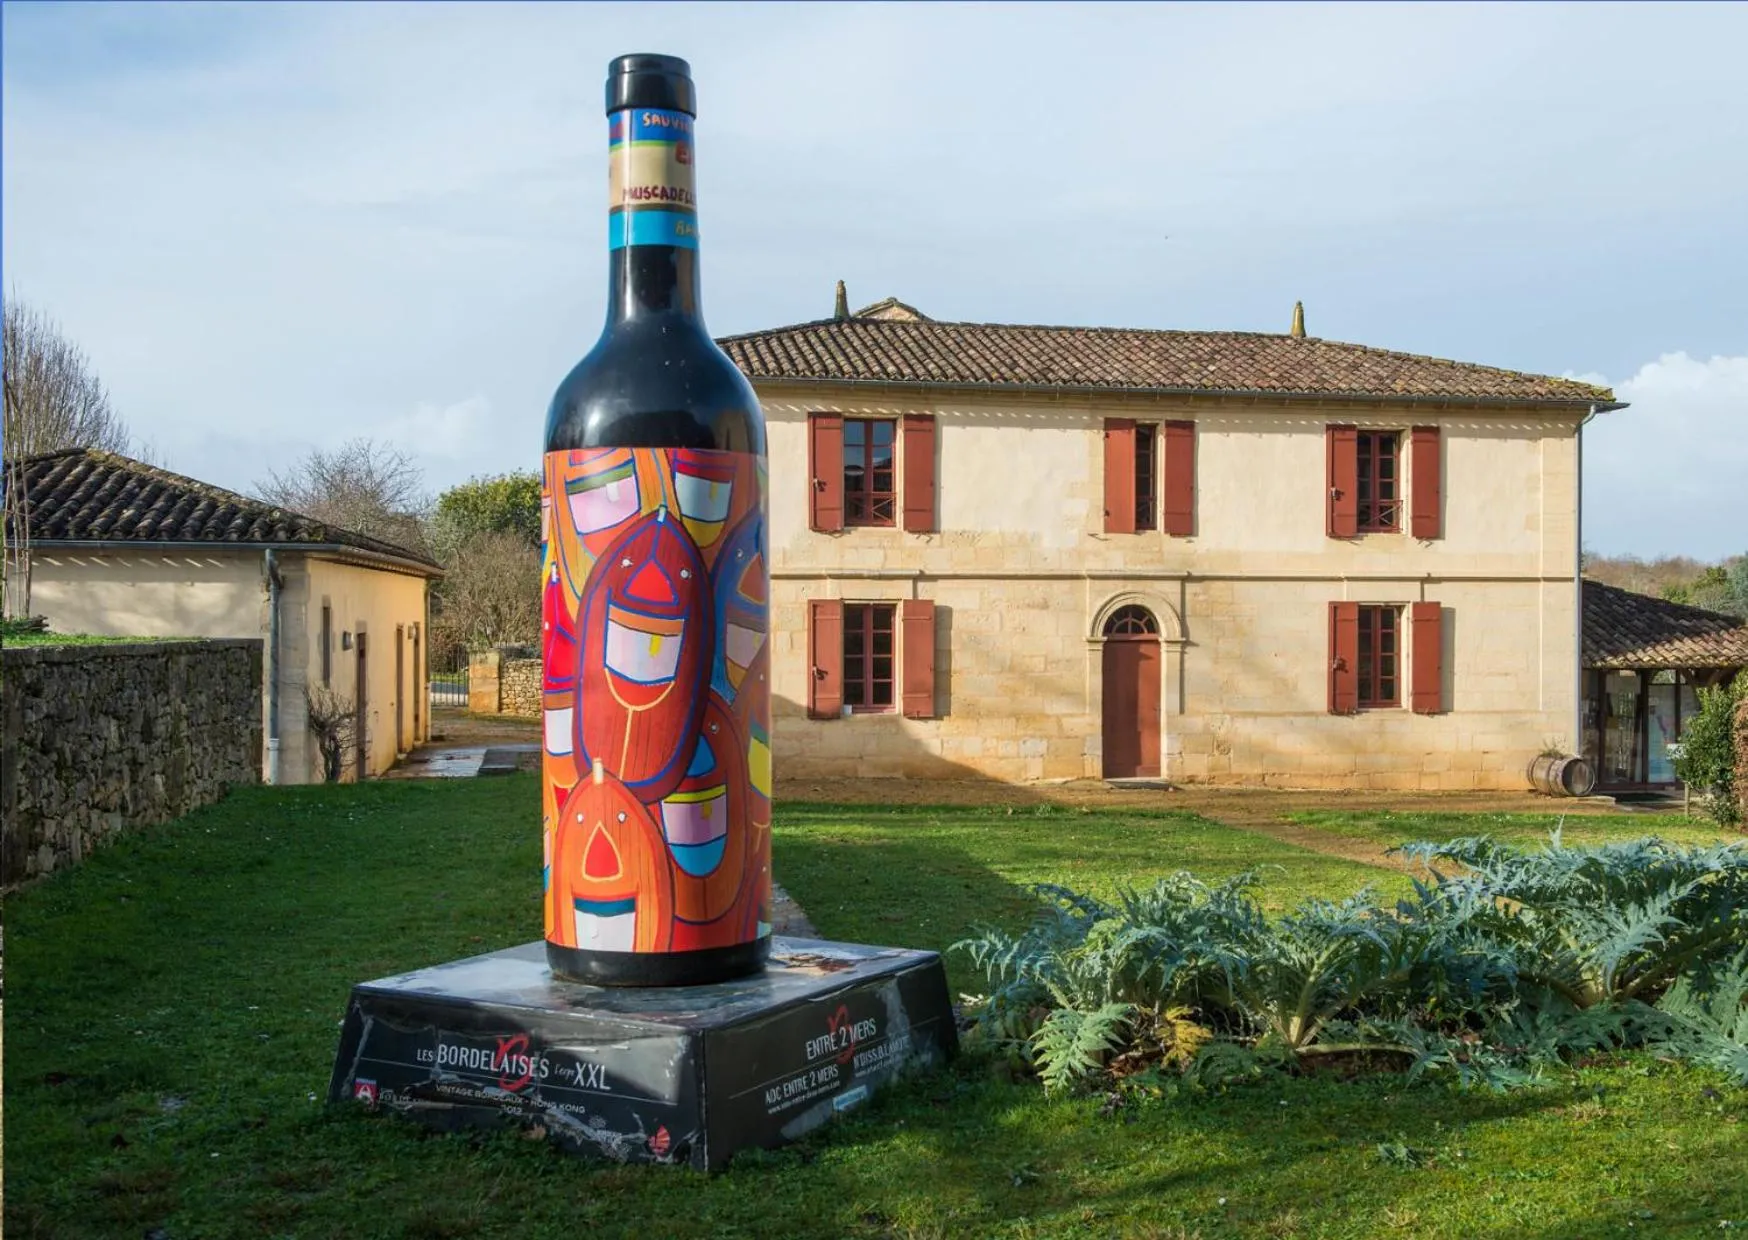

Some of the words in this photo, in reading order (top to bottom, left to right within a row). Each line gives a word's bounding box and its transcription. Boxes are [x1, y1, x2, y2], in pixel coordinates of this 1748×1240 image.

[806, 1032, 838, 1060] ENTRE
[839, 1026, 848, 1047] 2
[848, 1018, 877, 1043] MERS
[416, 1048, 434, 1062] LES
[437, 1043, 550, 1078] BORDELAISES
[573, 1061, 612, 1090] XXL
[783, 1076, 808, 1098] ENTRE
[809, 1071, 817, 1088] 2
[817, 1063, 839, 1084] MERS
[559, 1102, 585, 1114] KONG
